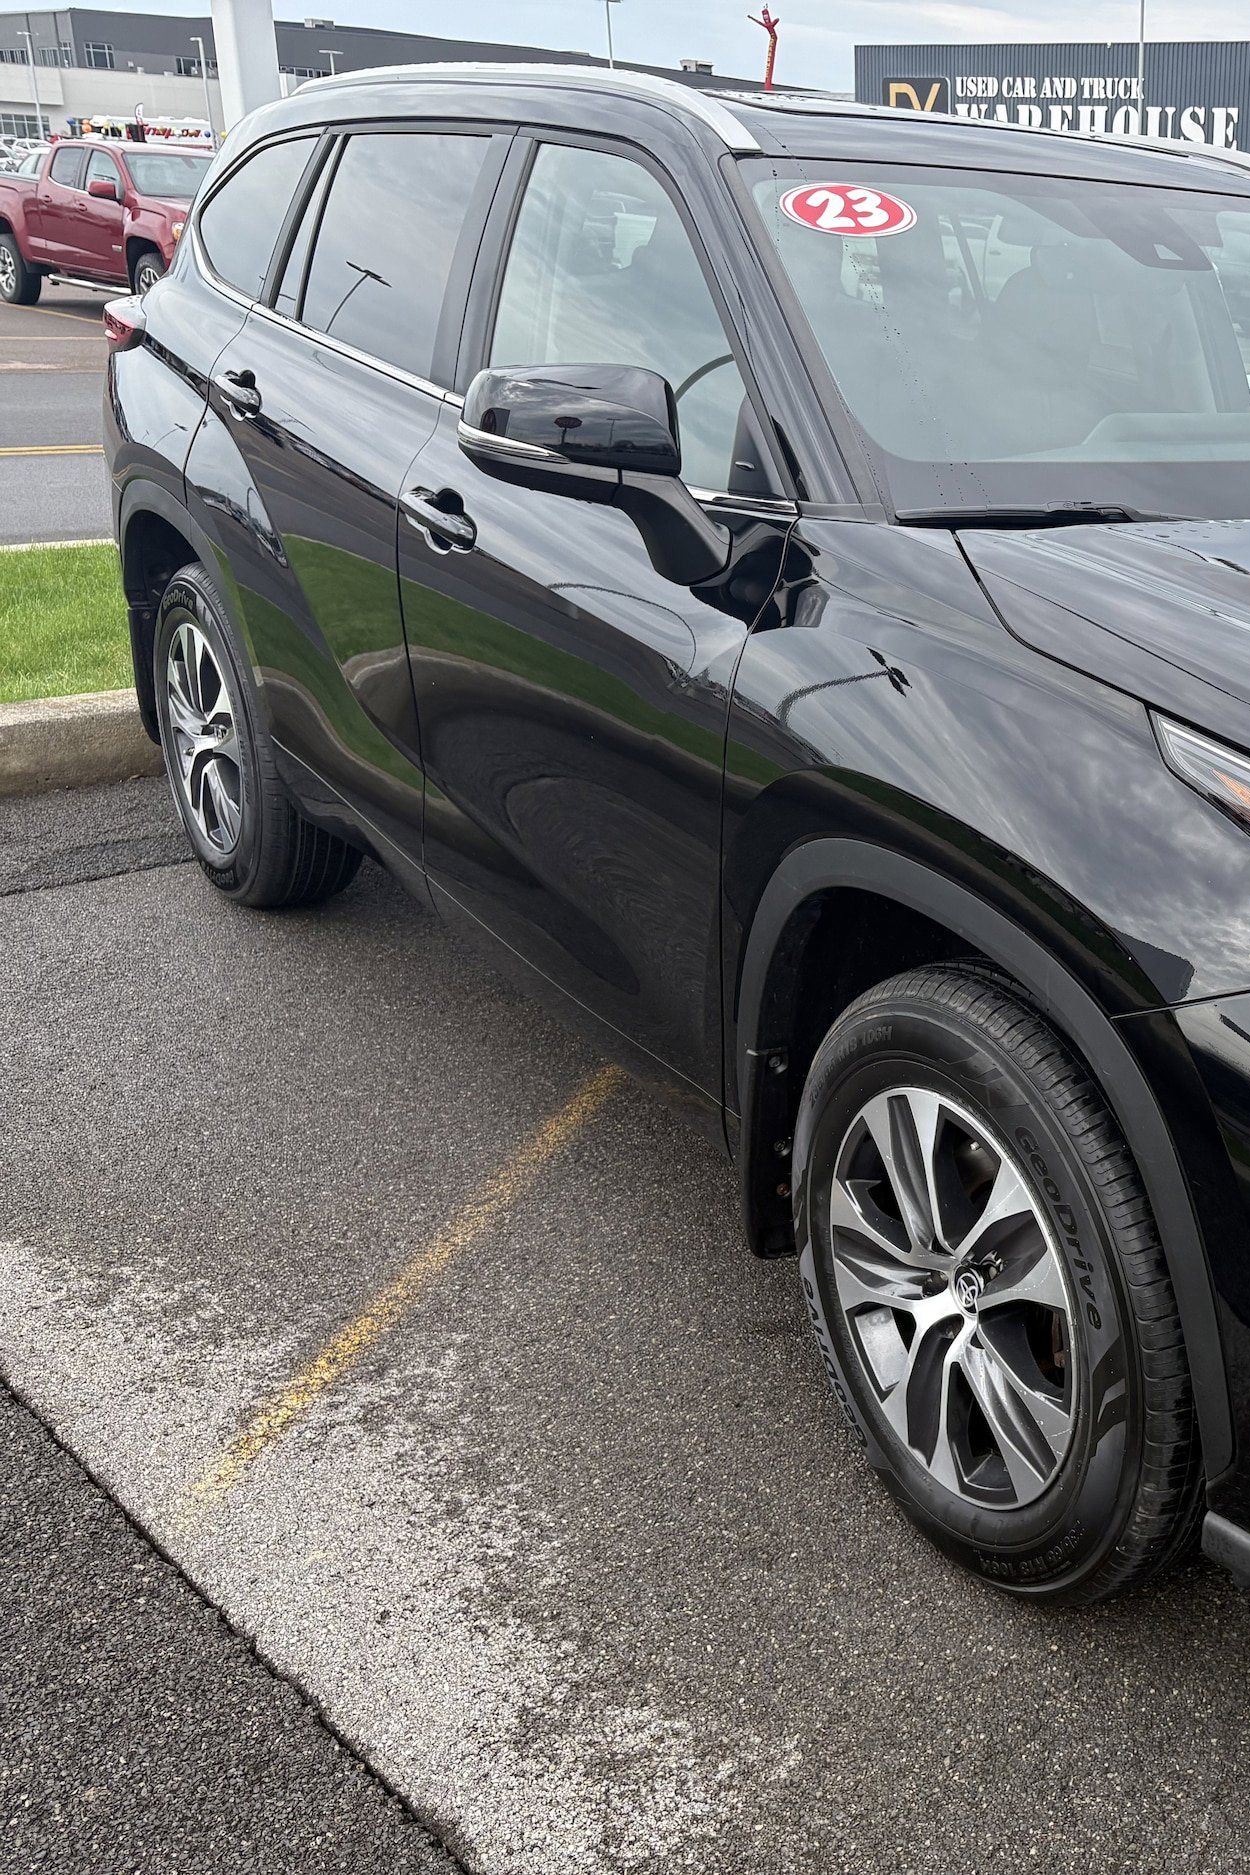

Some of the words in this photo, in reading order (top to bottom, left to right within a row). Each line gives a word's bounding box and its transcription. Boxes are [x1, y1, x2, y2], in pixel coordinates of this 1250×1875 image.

[955, 76, 999, 98] USED
[1001, 76, 1036, 99] CAR
[1040, 77, 1078, 99] AND
[1080, 77, 1145, 100] TRUCK
[805, 188, 890, 229] 23
[1014, 1126, 1102, 1330] GeoDrive
